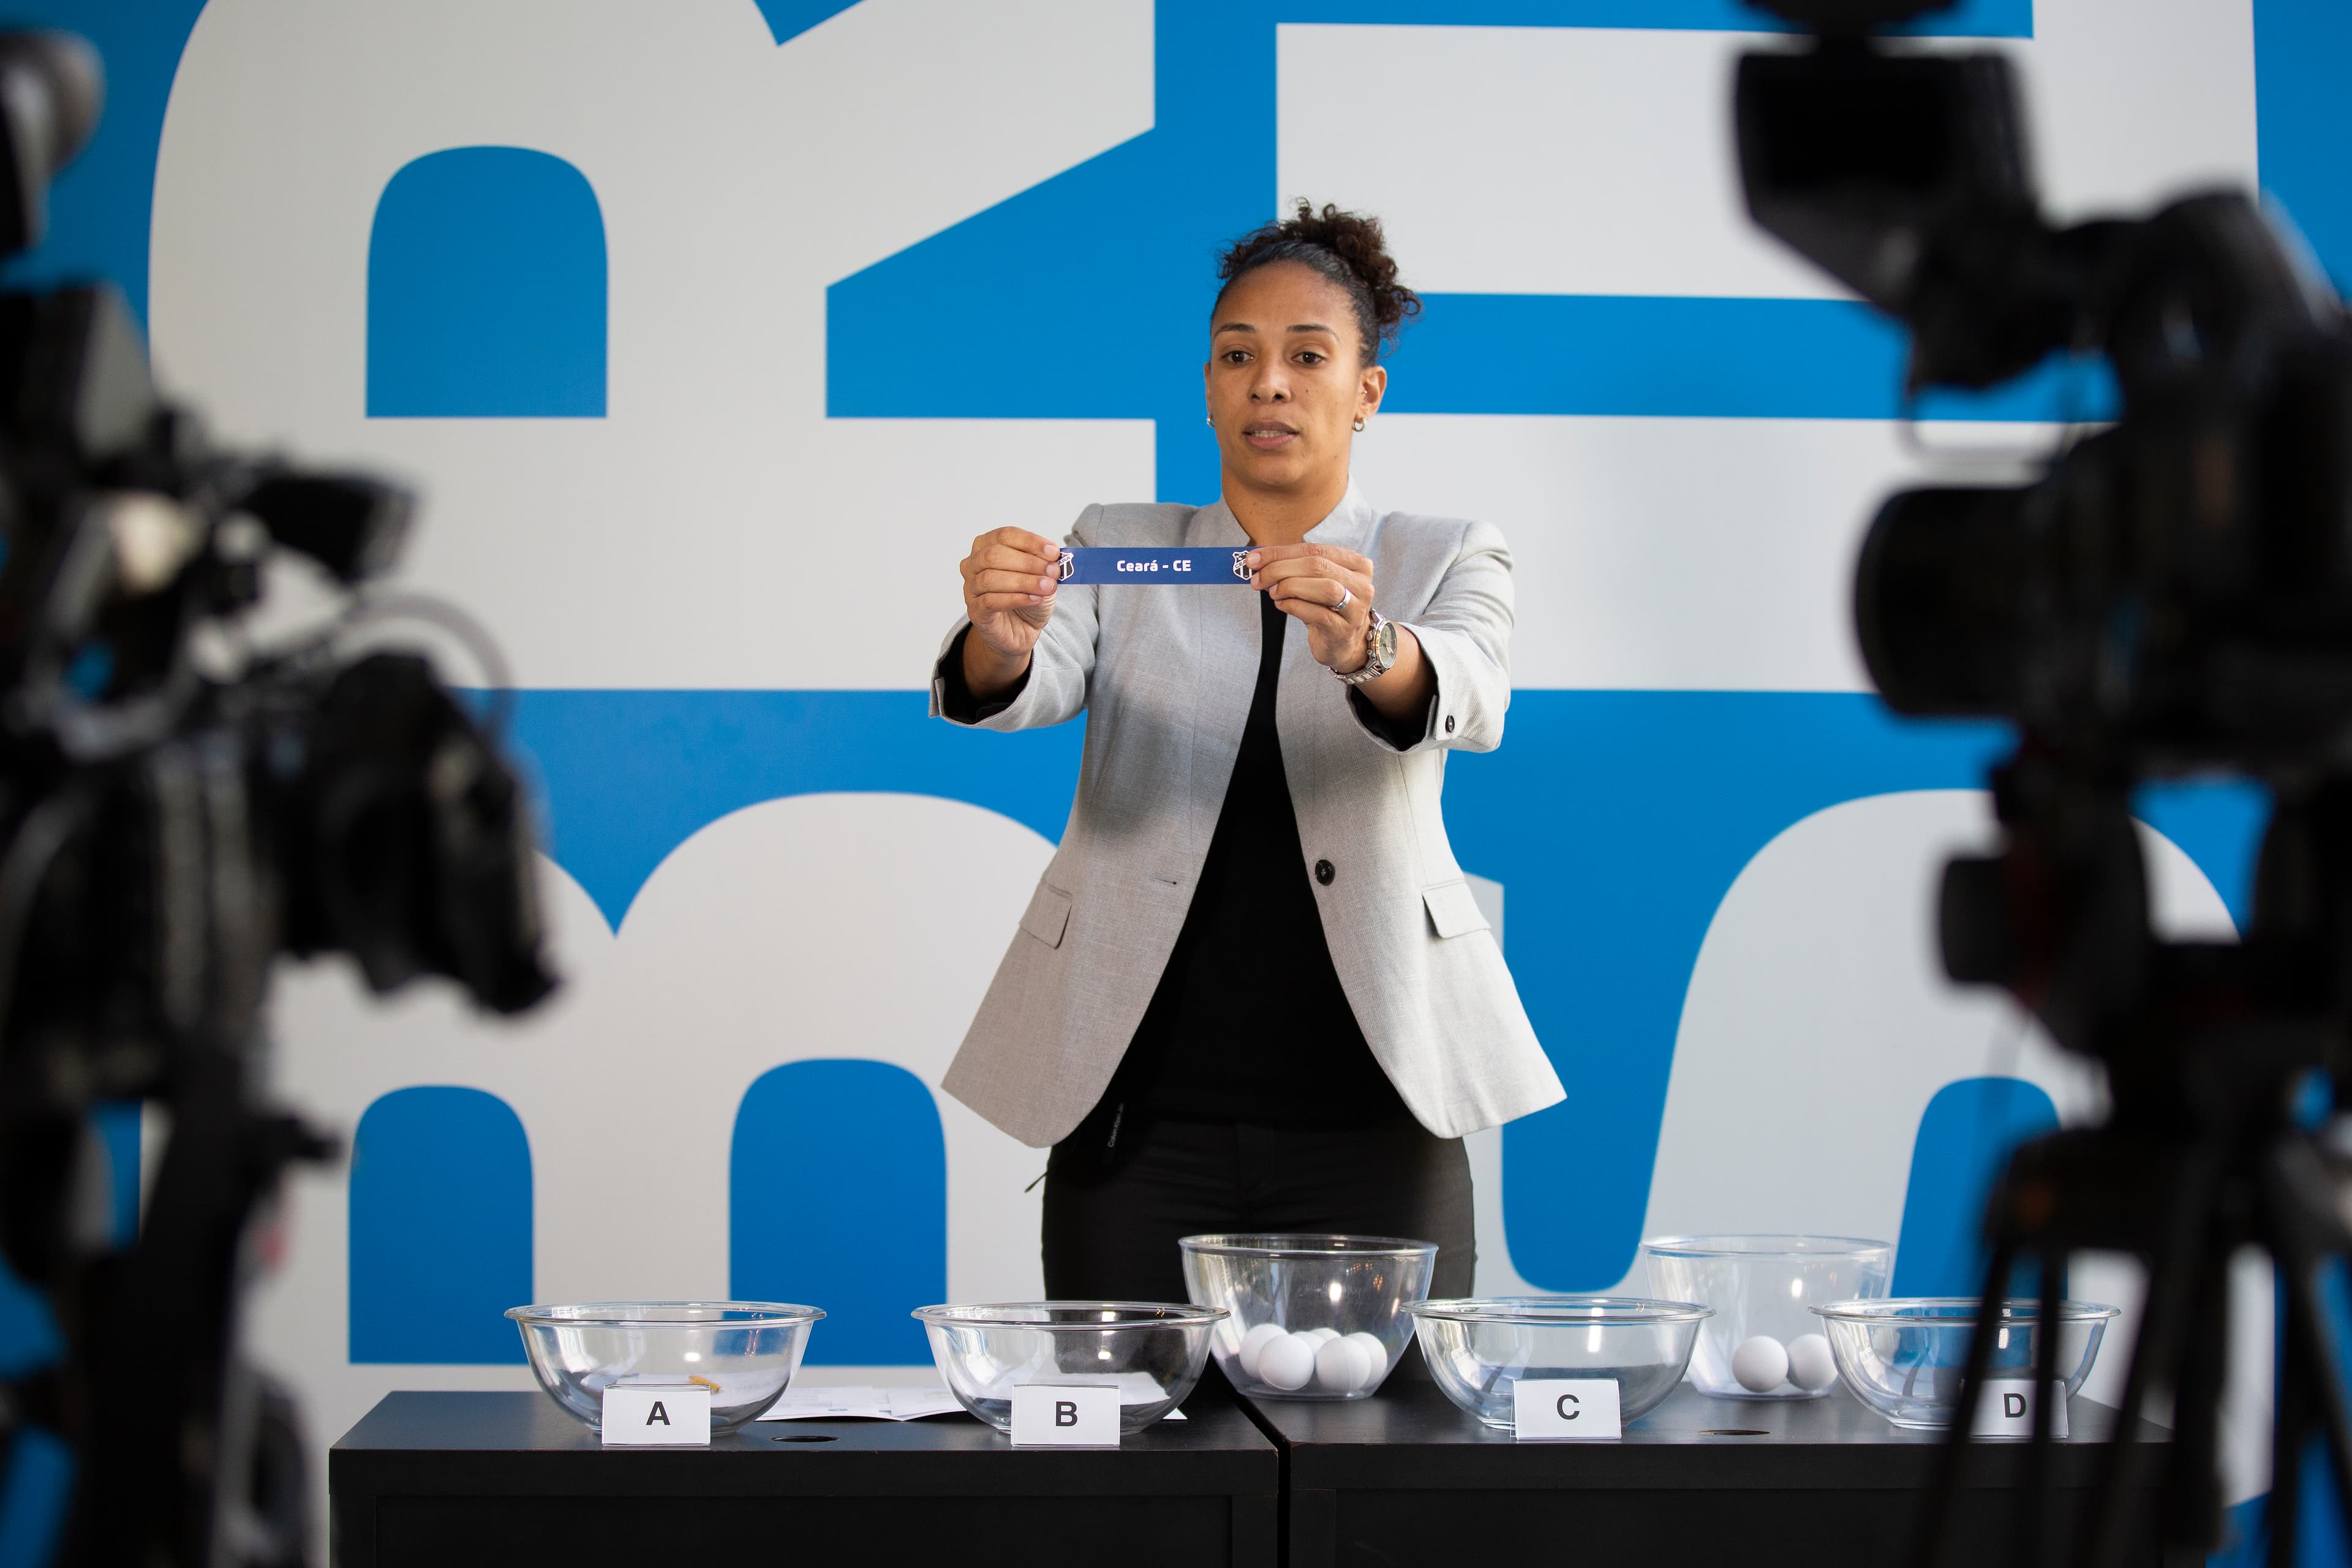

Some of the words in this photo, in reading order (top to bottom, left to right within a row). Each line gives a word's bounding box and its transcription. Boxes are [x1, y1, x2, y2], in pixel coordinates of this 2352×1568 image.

[1117, 559, 1158, 572] Ceará
[1173, 560, 1191, 571] CE
[646, 1401, 671, 1426] A
[1055, 1401, 1078, 1427] B
[1556, 1393, 1580, 1420] C
[2003, 1393, 2027, 1418] D
